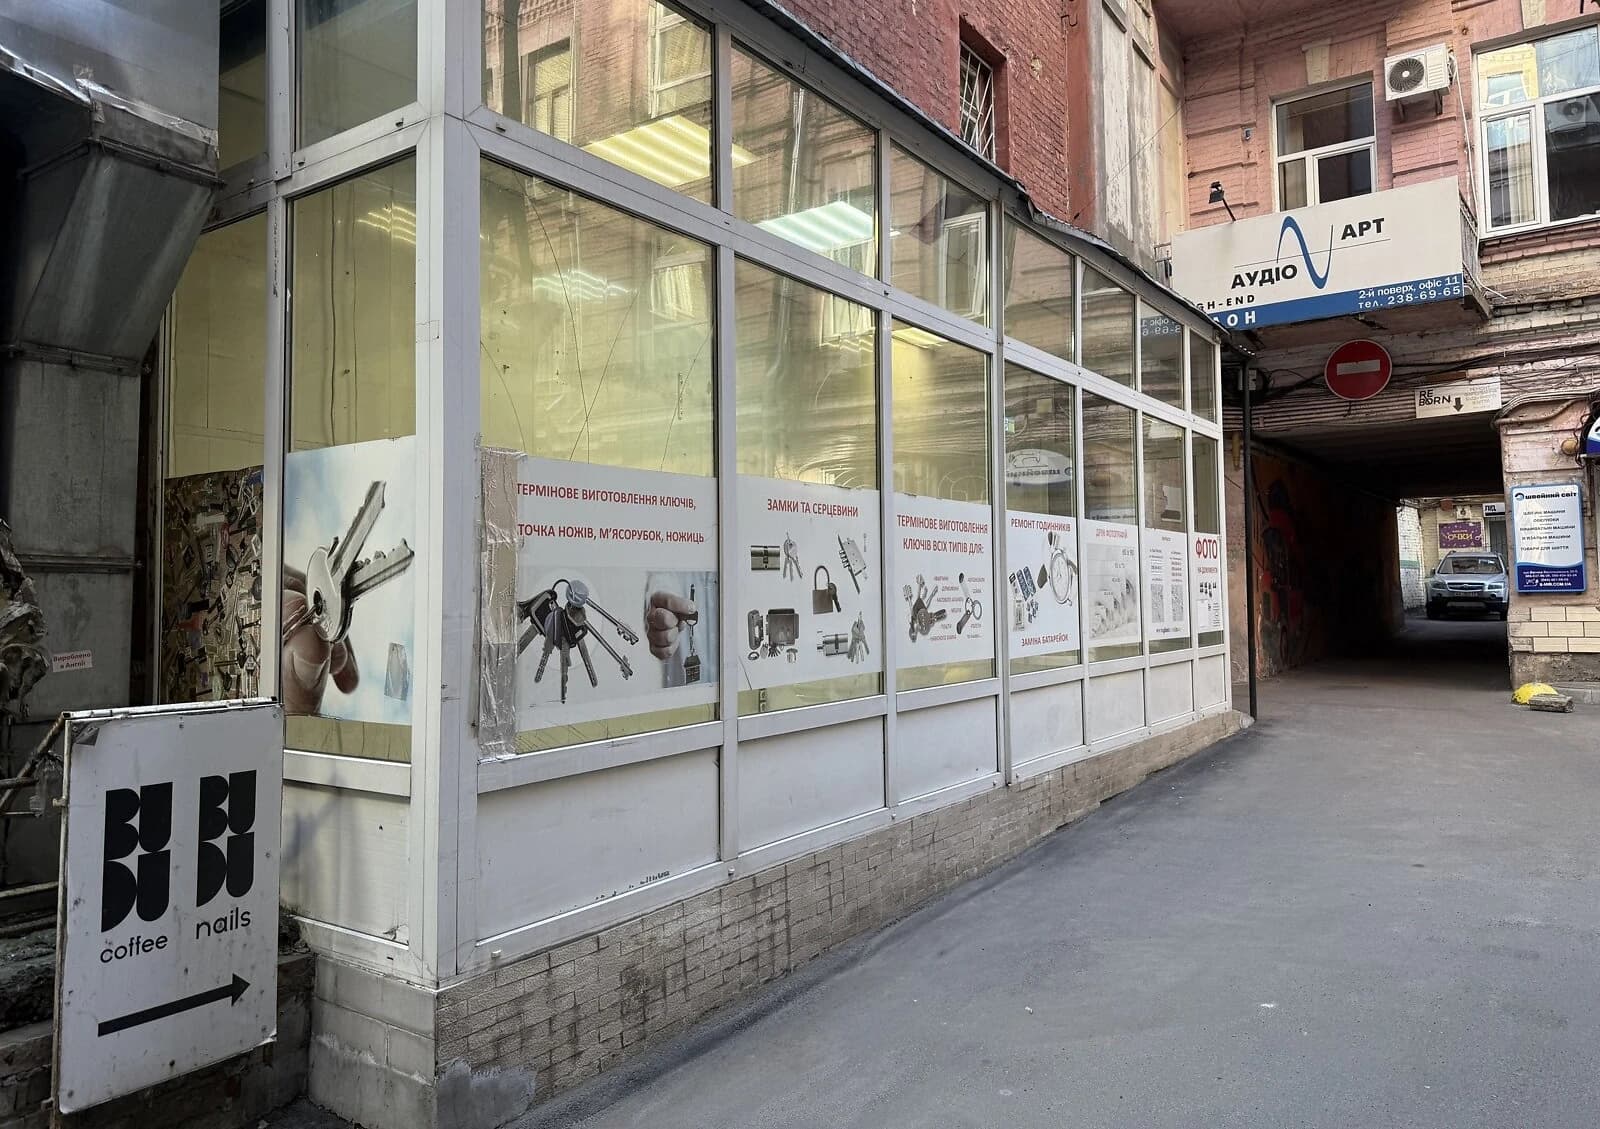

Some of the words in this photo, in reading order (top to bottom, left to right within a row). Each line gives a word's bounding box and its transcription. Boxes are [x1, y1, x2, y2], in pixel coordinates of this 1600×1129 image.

[1341, 218, 1385, 240] АРТ
[1231, 264, 1298, 289] АУДІО
[1358, 289, 1376, 299] 2-й
[1377, 284, 1416, 298] поверх,
[1418, 278, 1443, 292] офіс
[1445, 276, 1460, 286] 11
[1358, 300, 1383, 310] тел.
[1387, 286, 1461, 306] 238-69-65
[1419, 396, 1451, 406] BORN
[1420, 390, 1434, 398] RE
[516, 484, 579, 500] ТЕРМІНОВЕ
[582, 489, 658, 506] ВИГОТОВЛЕННЯ
[660, 496, 697, 510] КЛЮЧІВ,
[768, 498, 799, 513] ЗАМКИ
[800, 502, 811, 514] ТА
[812, 502, 859, 518] СЕРЦЕВИНИ
[517, 524, 556, 538] ТОЧКА
[558, 526, 597, 540] НОЖІВ,
[666, 532, 704, 544] НОЖИЦЬ
[897, 514, 938, 530] ТЕРМІНОВЕ
[939, 520, 988, 534] ВИГОТОВЛЕННЯ
[1011, 518, 1036, 529] РЕМОНТ
[1036, 520, 1071, 532] ГОДИННИКІВ
[903, 538, 932, 550] КЛЮЧІВ
[933, 540, 948, 552] ВСІХ
[949, 542, 968, 553] ТИПІВ
[968, 544, 984, 555] ДЛЯ:
[1196, 537, 1218, 560] ФОТО
[1022, 636, 1042, 646] ЗАМІНА
[1042, 633, 1069, 644] БАТАРЕЙОК
[196, 906, 252, 940] nails
[100, 932, 168, 964] coffee
